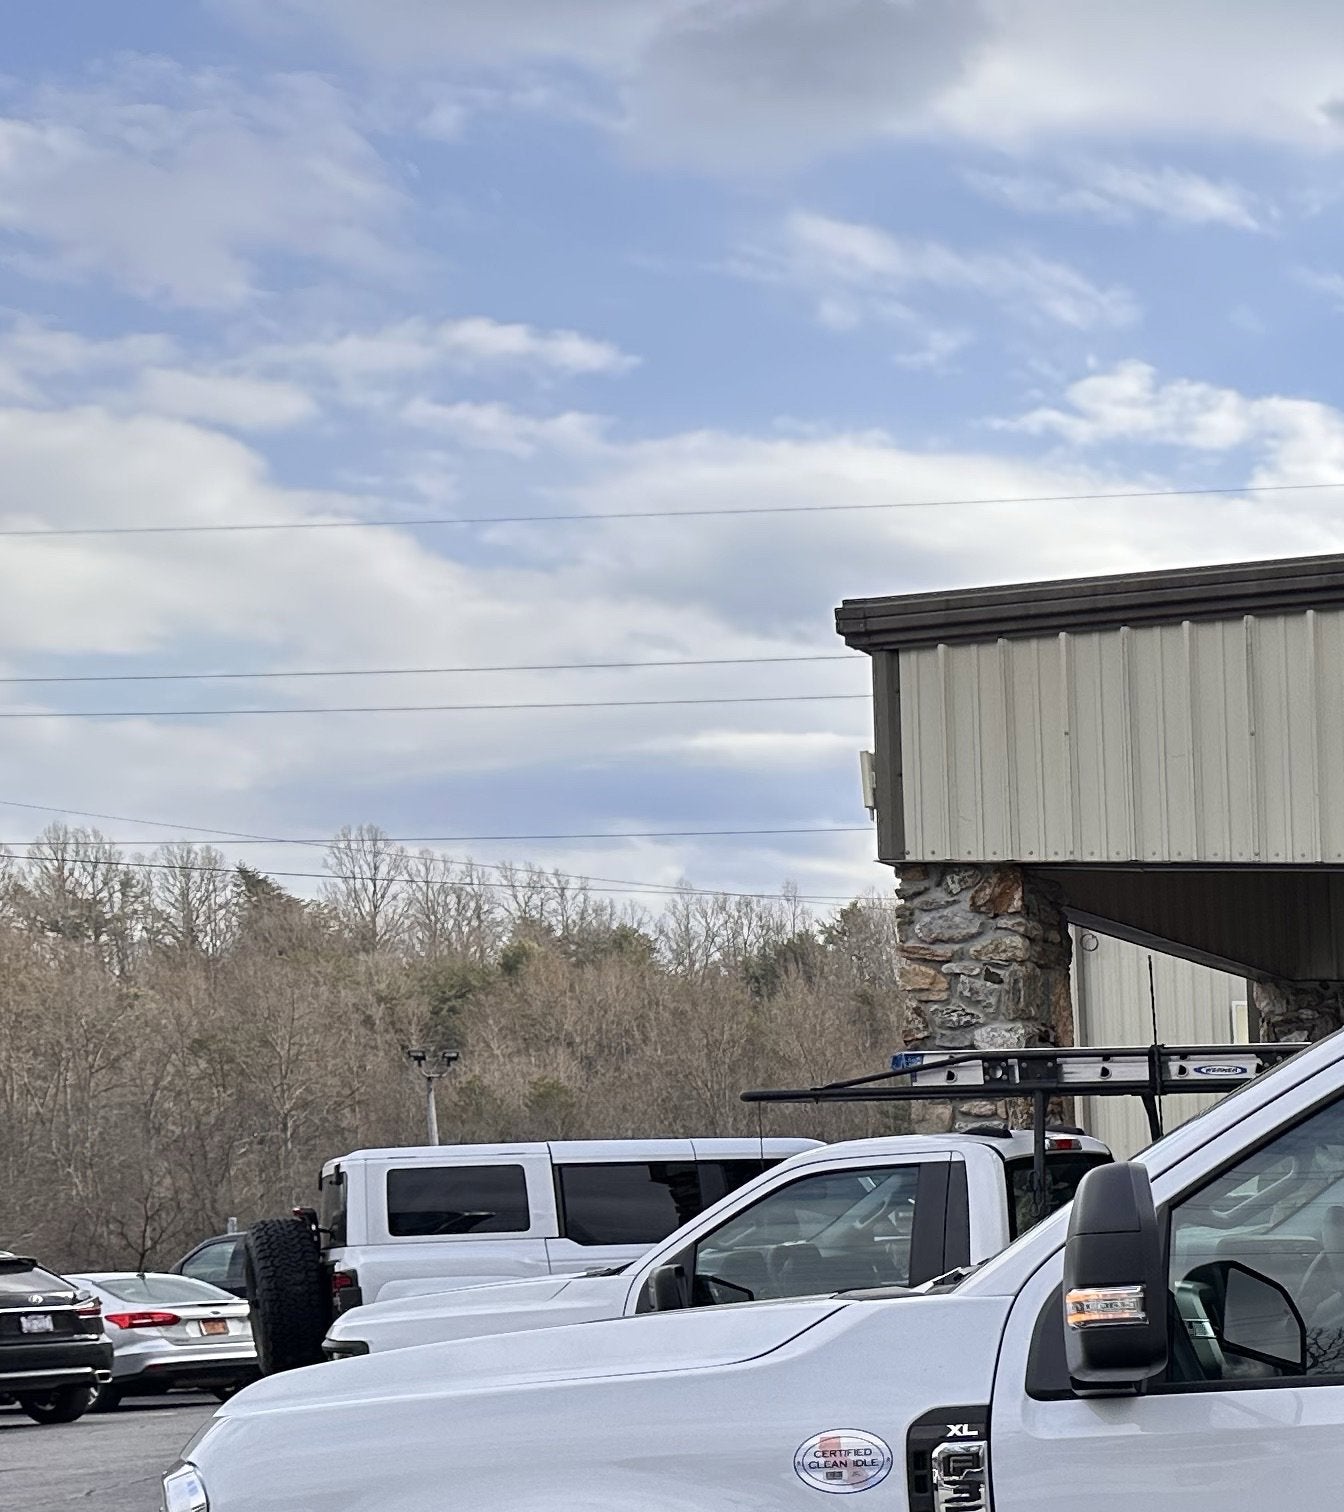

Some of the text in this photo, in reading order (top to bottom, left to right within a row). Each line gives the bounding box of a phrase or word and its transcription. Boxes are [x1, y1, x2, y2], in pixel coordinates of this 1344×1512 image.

[946, 1424, 978, 1437] XL
[813, 1448, 873, 1459] CERTIFIED
[807, 1458, 880, 1470] CLEAN IDLE
